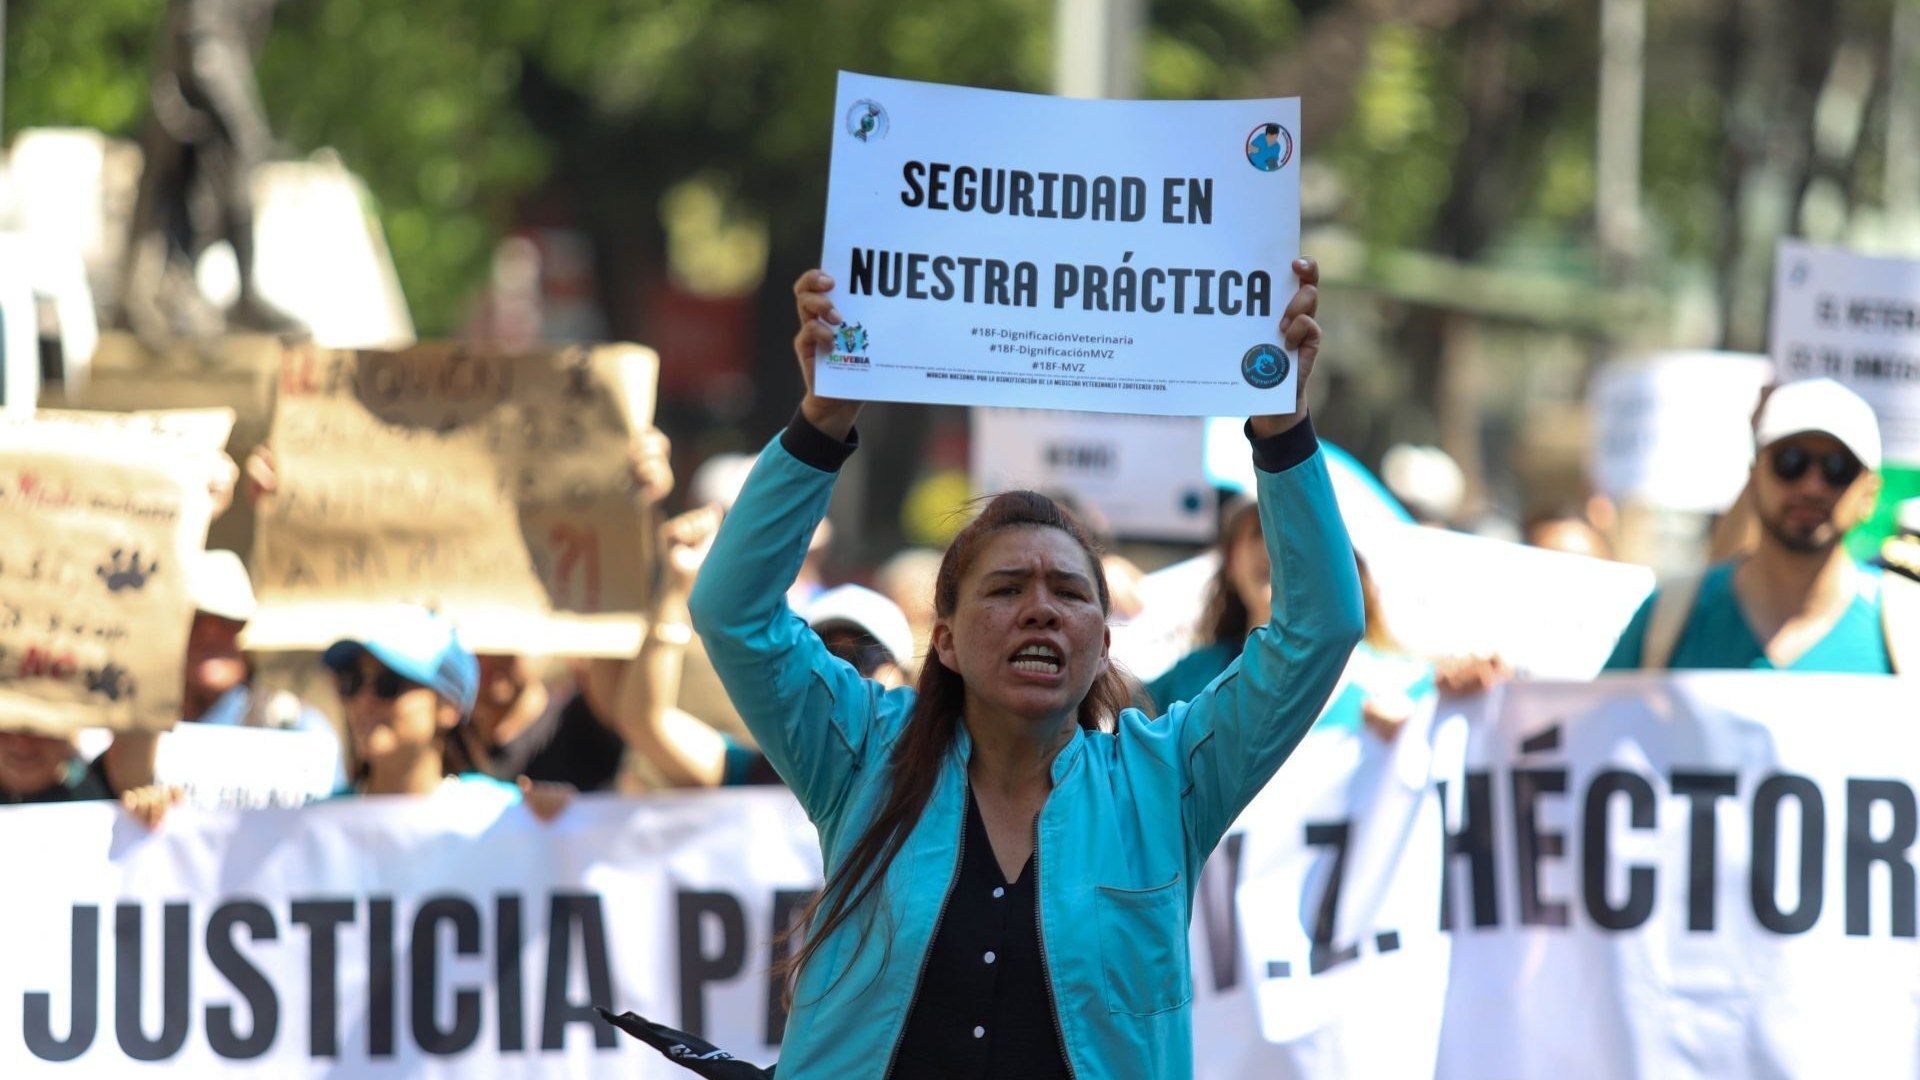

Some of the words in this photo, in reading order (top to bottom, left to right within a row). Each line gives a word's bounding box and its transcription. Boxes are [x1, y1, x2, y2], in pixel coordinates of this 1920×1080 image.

[900, 160, 1147, 223] SEGURIDAD
[1162, 177, 1214, 225] EN
[849, 247, 1038, 308] NUESTRA
[1053, 251, 1272, 317] PRÁCTICA
[971, 327, 1134, 345] #18F-DignificaciónVeterinaria
[990, 343, 1115, 359] #18F-DignificaciónMVZ
[1031, 361, 1087, 373] #18F-MVZ
[22, 888, 619, 1063] JUSTICIA
[1437, 724, 1920, 938] HÉCTOR
